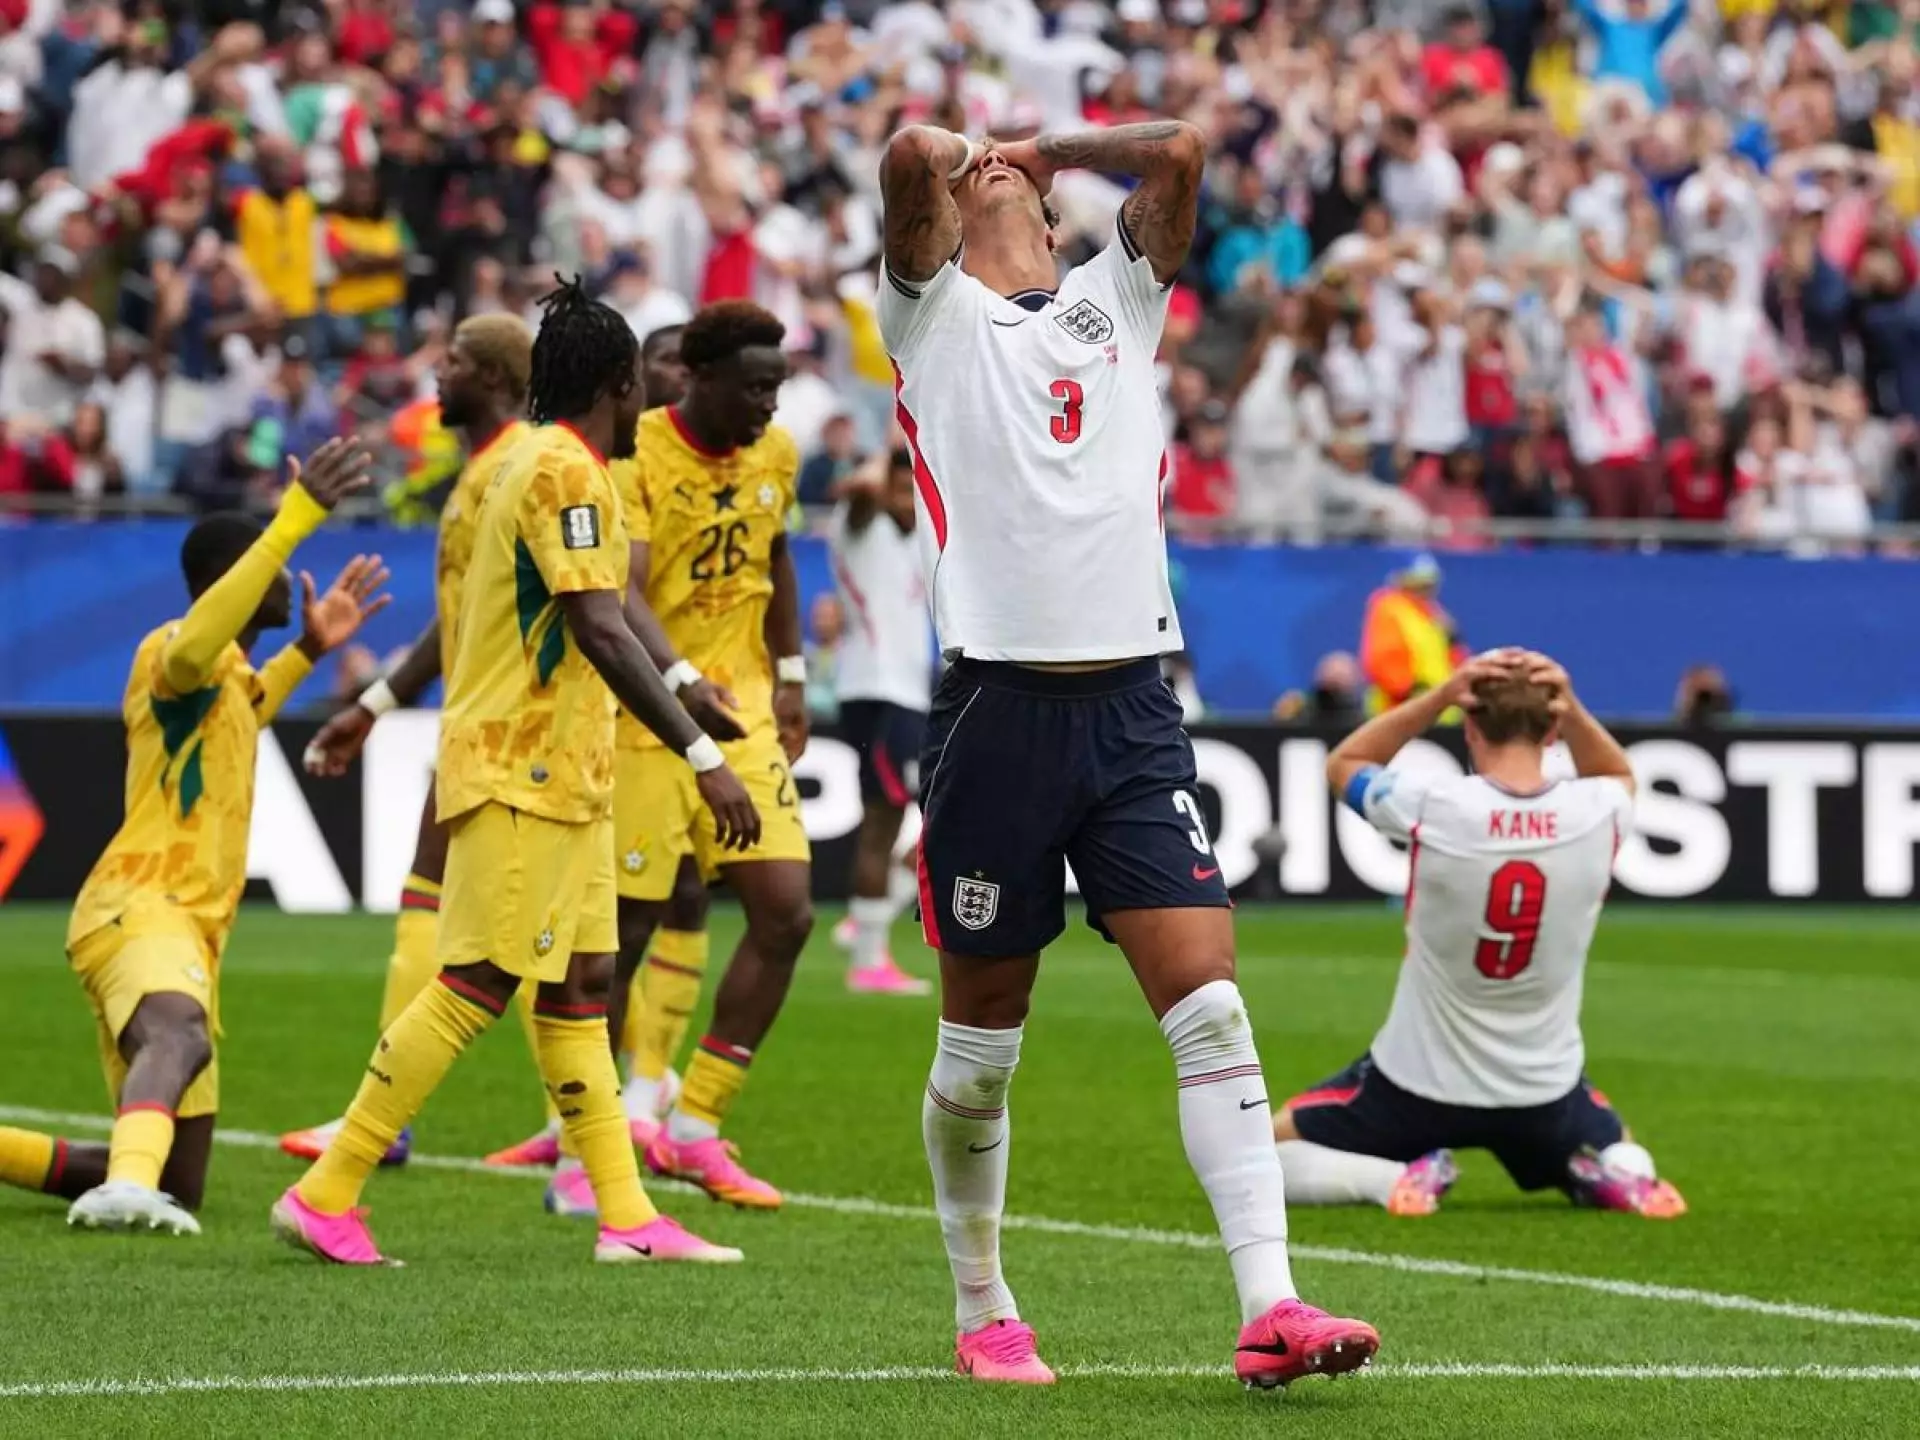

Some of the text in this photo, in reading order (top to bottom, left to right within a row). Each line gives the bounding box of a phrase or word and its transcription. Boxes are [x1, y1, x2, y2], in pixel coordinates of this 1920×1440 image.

[1049, 379, 1083, 443] 3
[691, 521, 749, 580] 26
[1172, 789, 1211, 855] 3
[1488, 809, 1558, 840] KANE
[1473, 860, 1546, 980] 9
